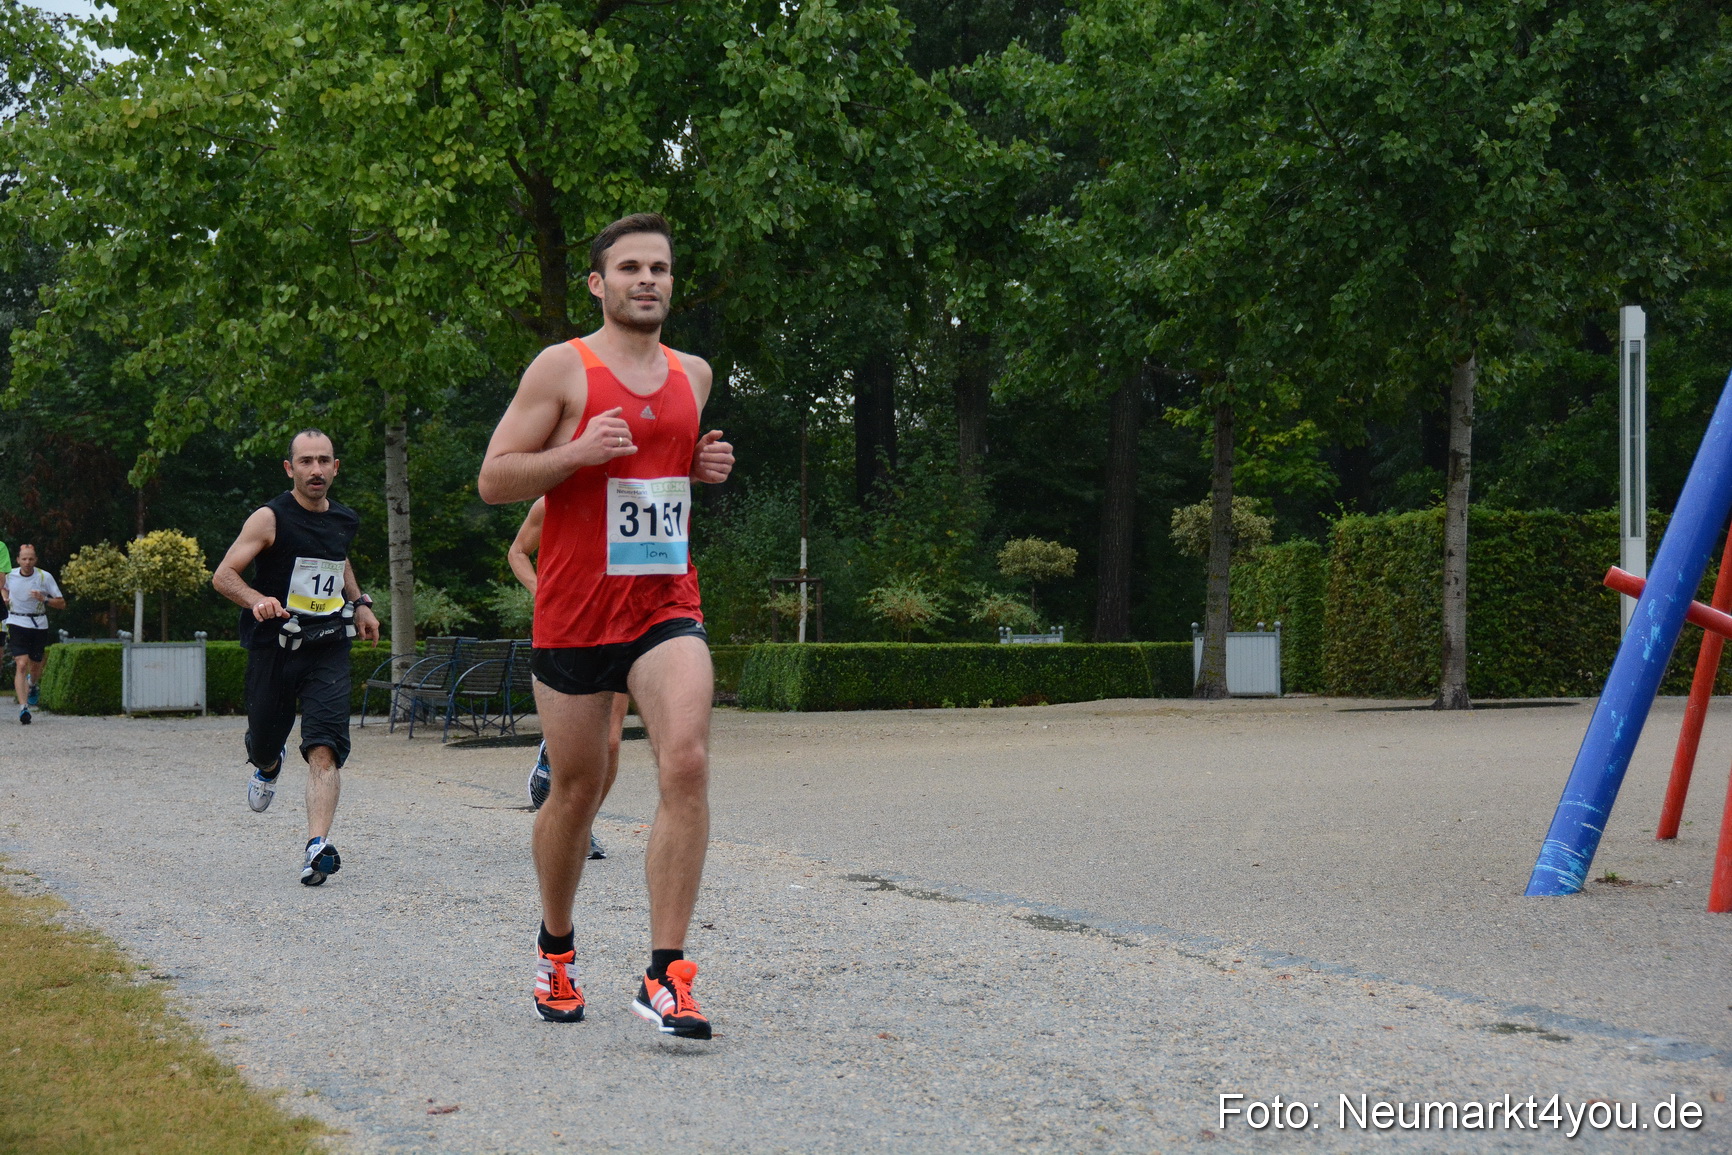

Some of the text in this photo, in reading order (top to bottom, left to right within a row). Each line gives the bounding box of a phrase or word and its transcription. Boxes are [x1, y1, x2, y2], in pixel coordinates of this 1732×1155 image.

[620, 501, 682, 537] 3151
[640, 542, 668, 559] Tom
[312, 574, 334, 596] 14
